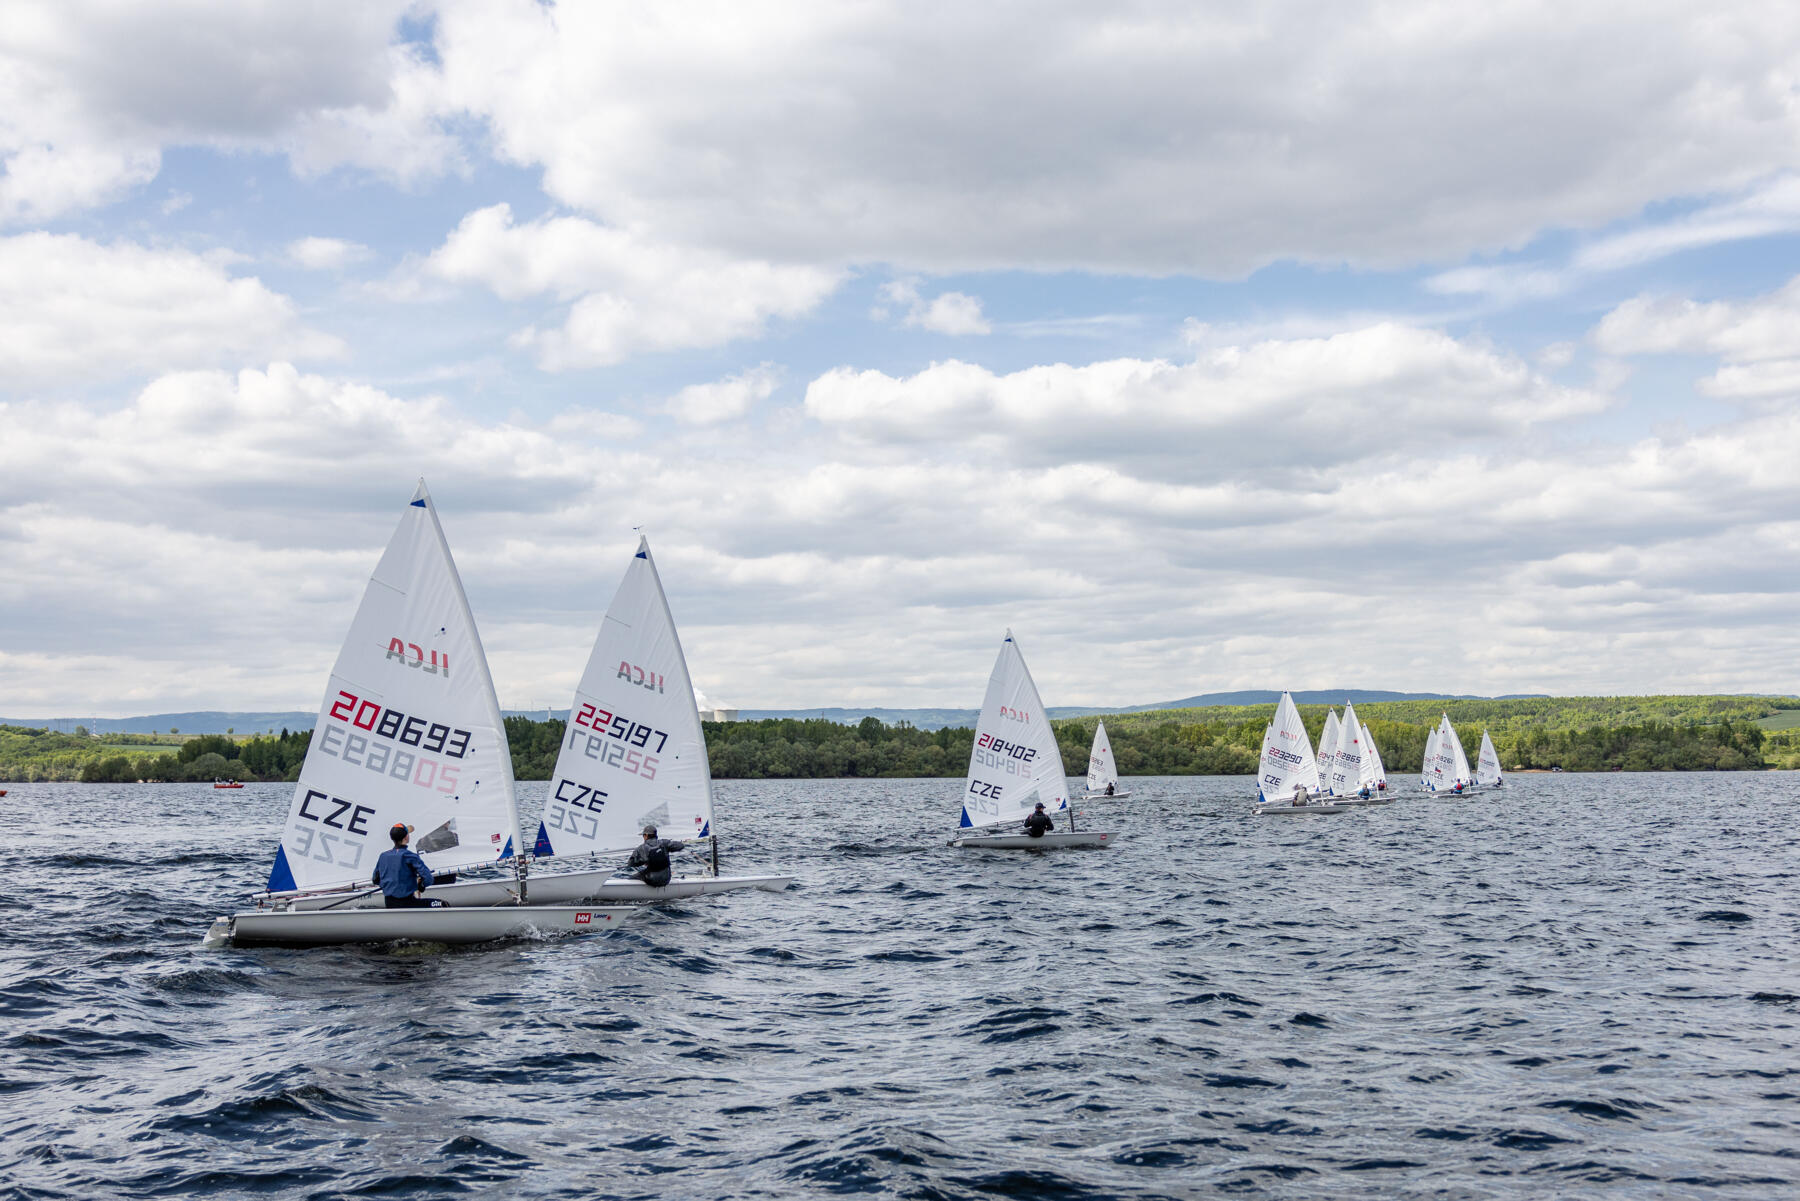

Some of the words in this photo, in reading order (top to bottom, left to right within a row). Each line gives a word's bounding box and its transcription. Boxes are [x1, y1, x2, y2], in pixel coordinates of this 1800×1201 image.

[329, 690, 472, 759] 208693
[575, 703, 668, 754] 225197
[978, 733, 1037, 762] 218402
[1268, 747, 1303, 765] 223290
[1336, 750, 1361, 764] 212865
[1264, 774, 1281, 786] CZE
[1332, 772, 1346, 782] CZE
[554, 778, 608, 813] CZE
[969, 779, 1003, 800] CZE
[298, 789, 376, 836] CZE
[577, 914, 590, 922] HH
